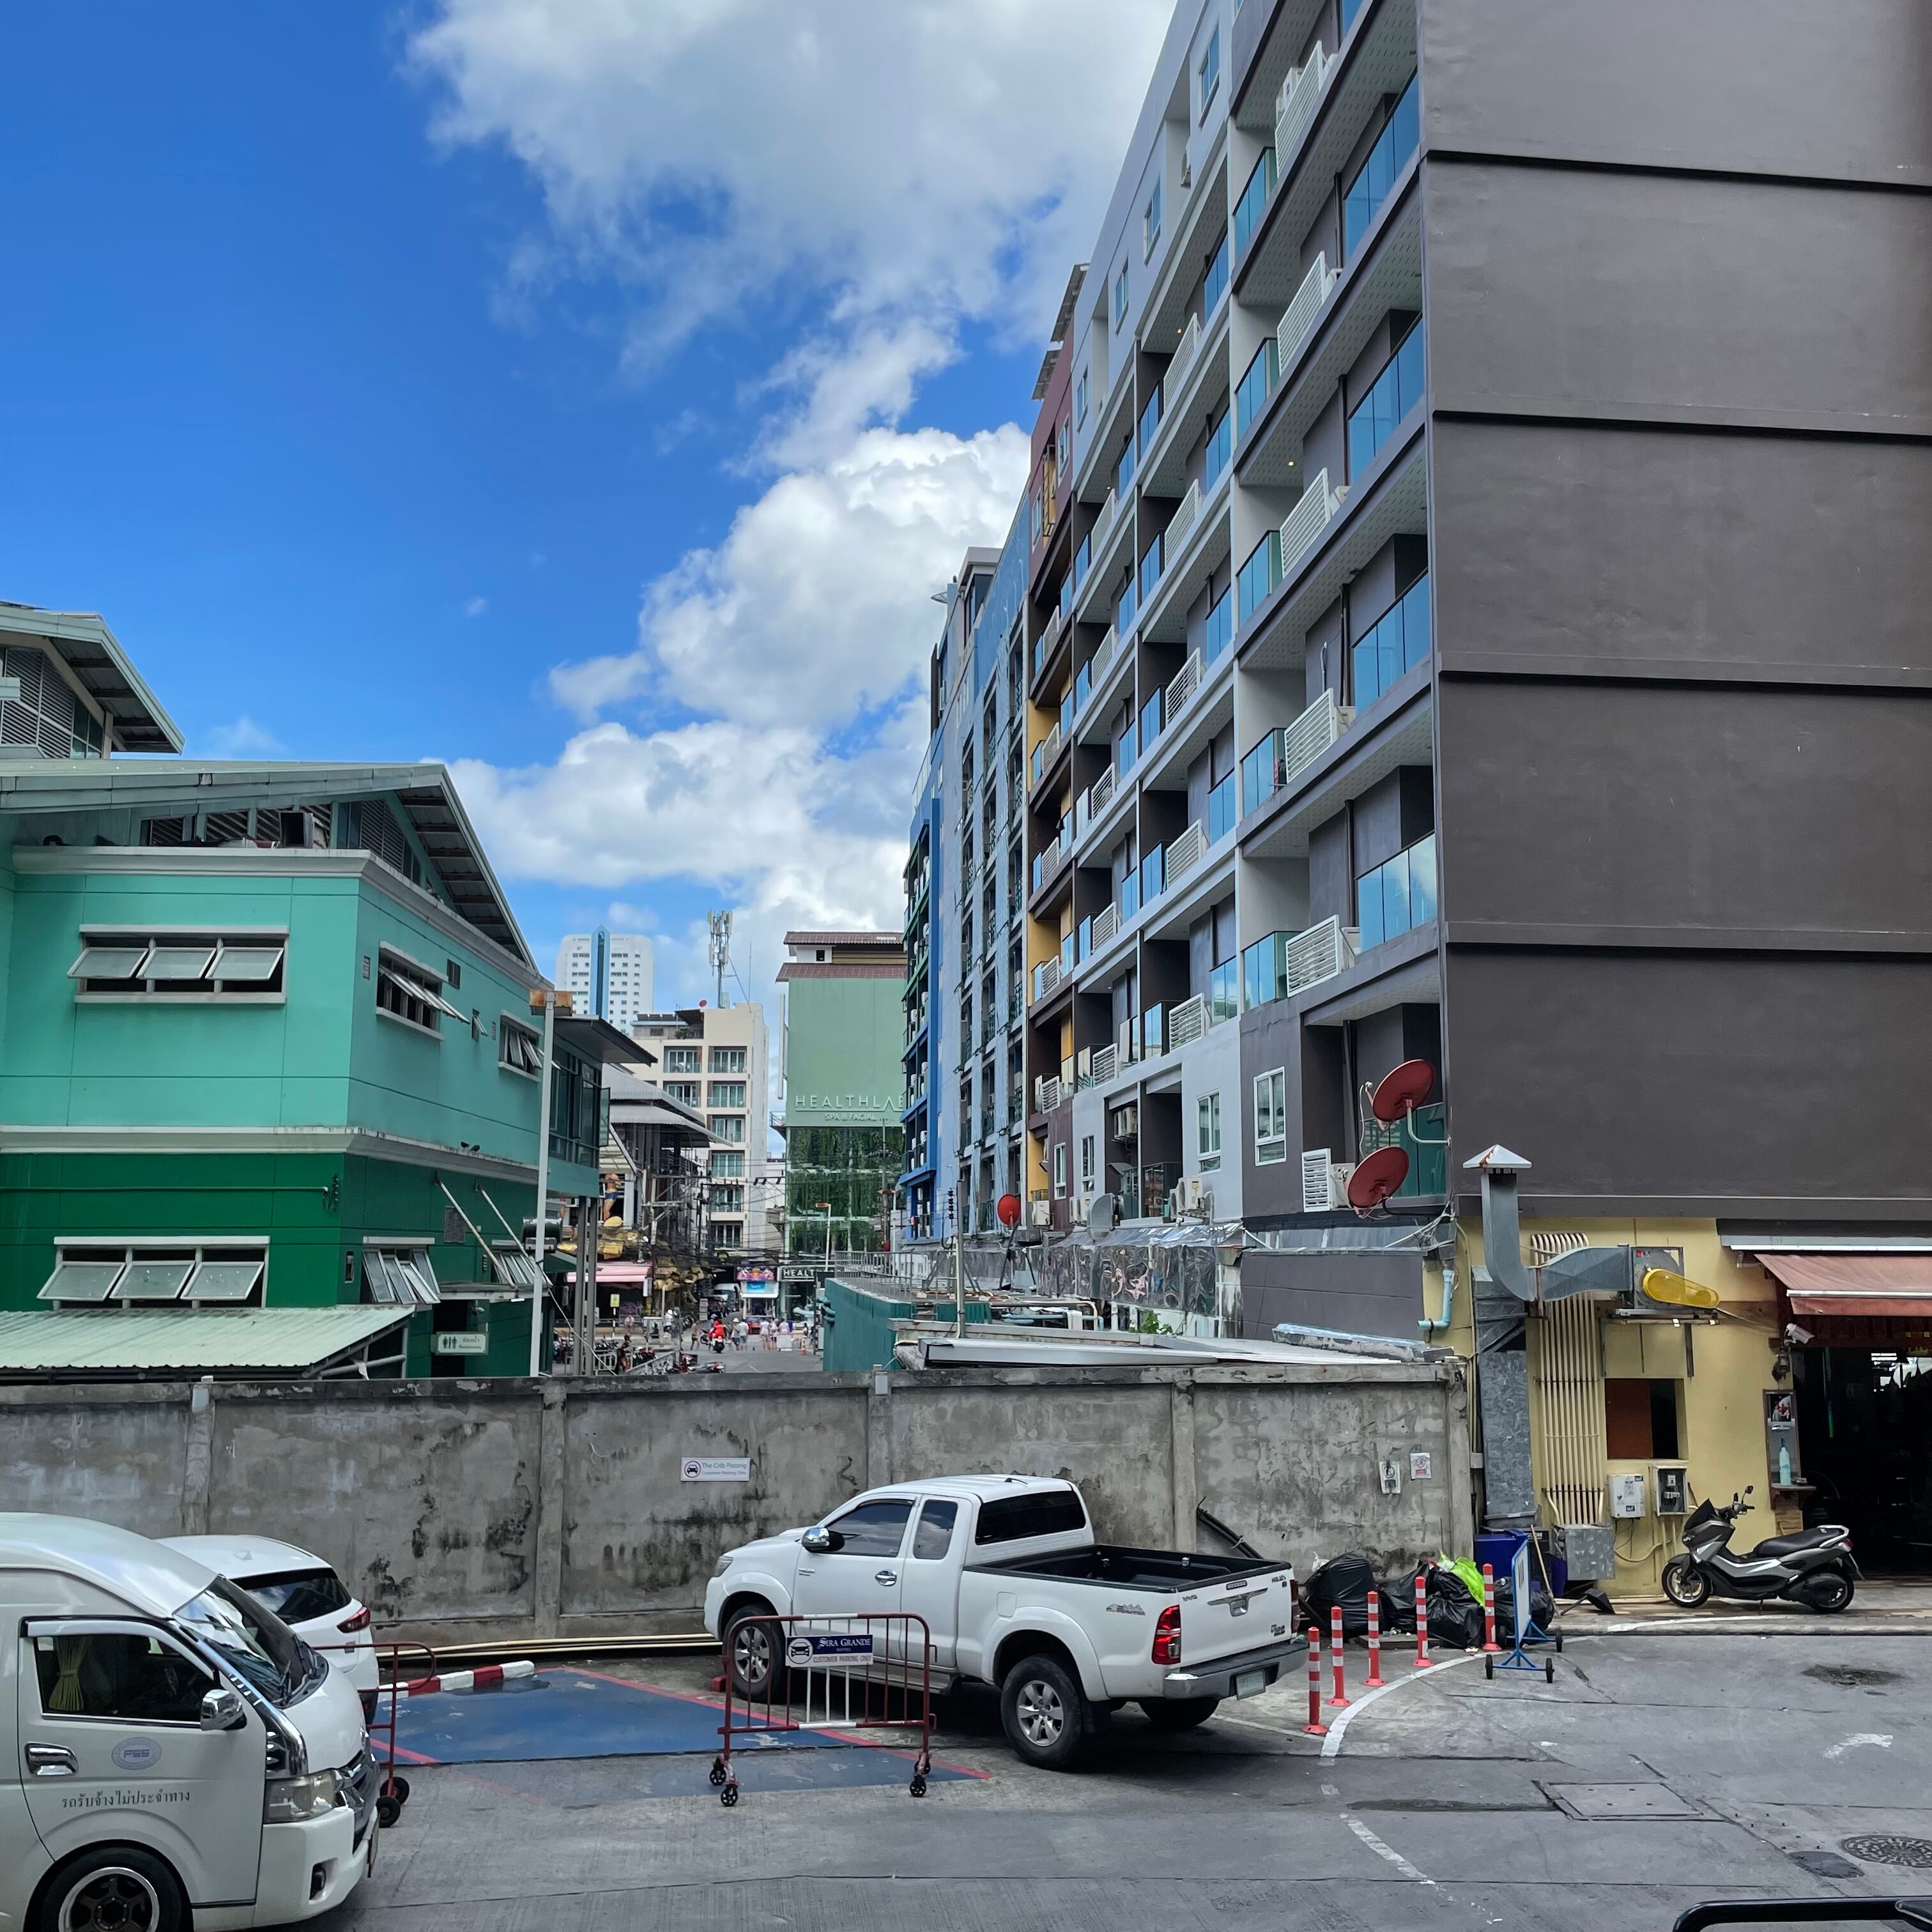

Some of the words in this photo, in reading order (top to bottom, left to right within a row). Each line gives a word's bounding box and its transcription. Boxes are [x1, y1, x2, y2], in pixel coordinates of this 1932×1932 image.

[840, 1638, 871, 1646] GRANDE
[62, 1789, 191, 1808] รถรับจ้างไม่ประจำทาง
